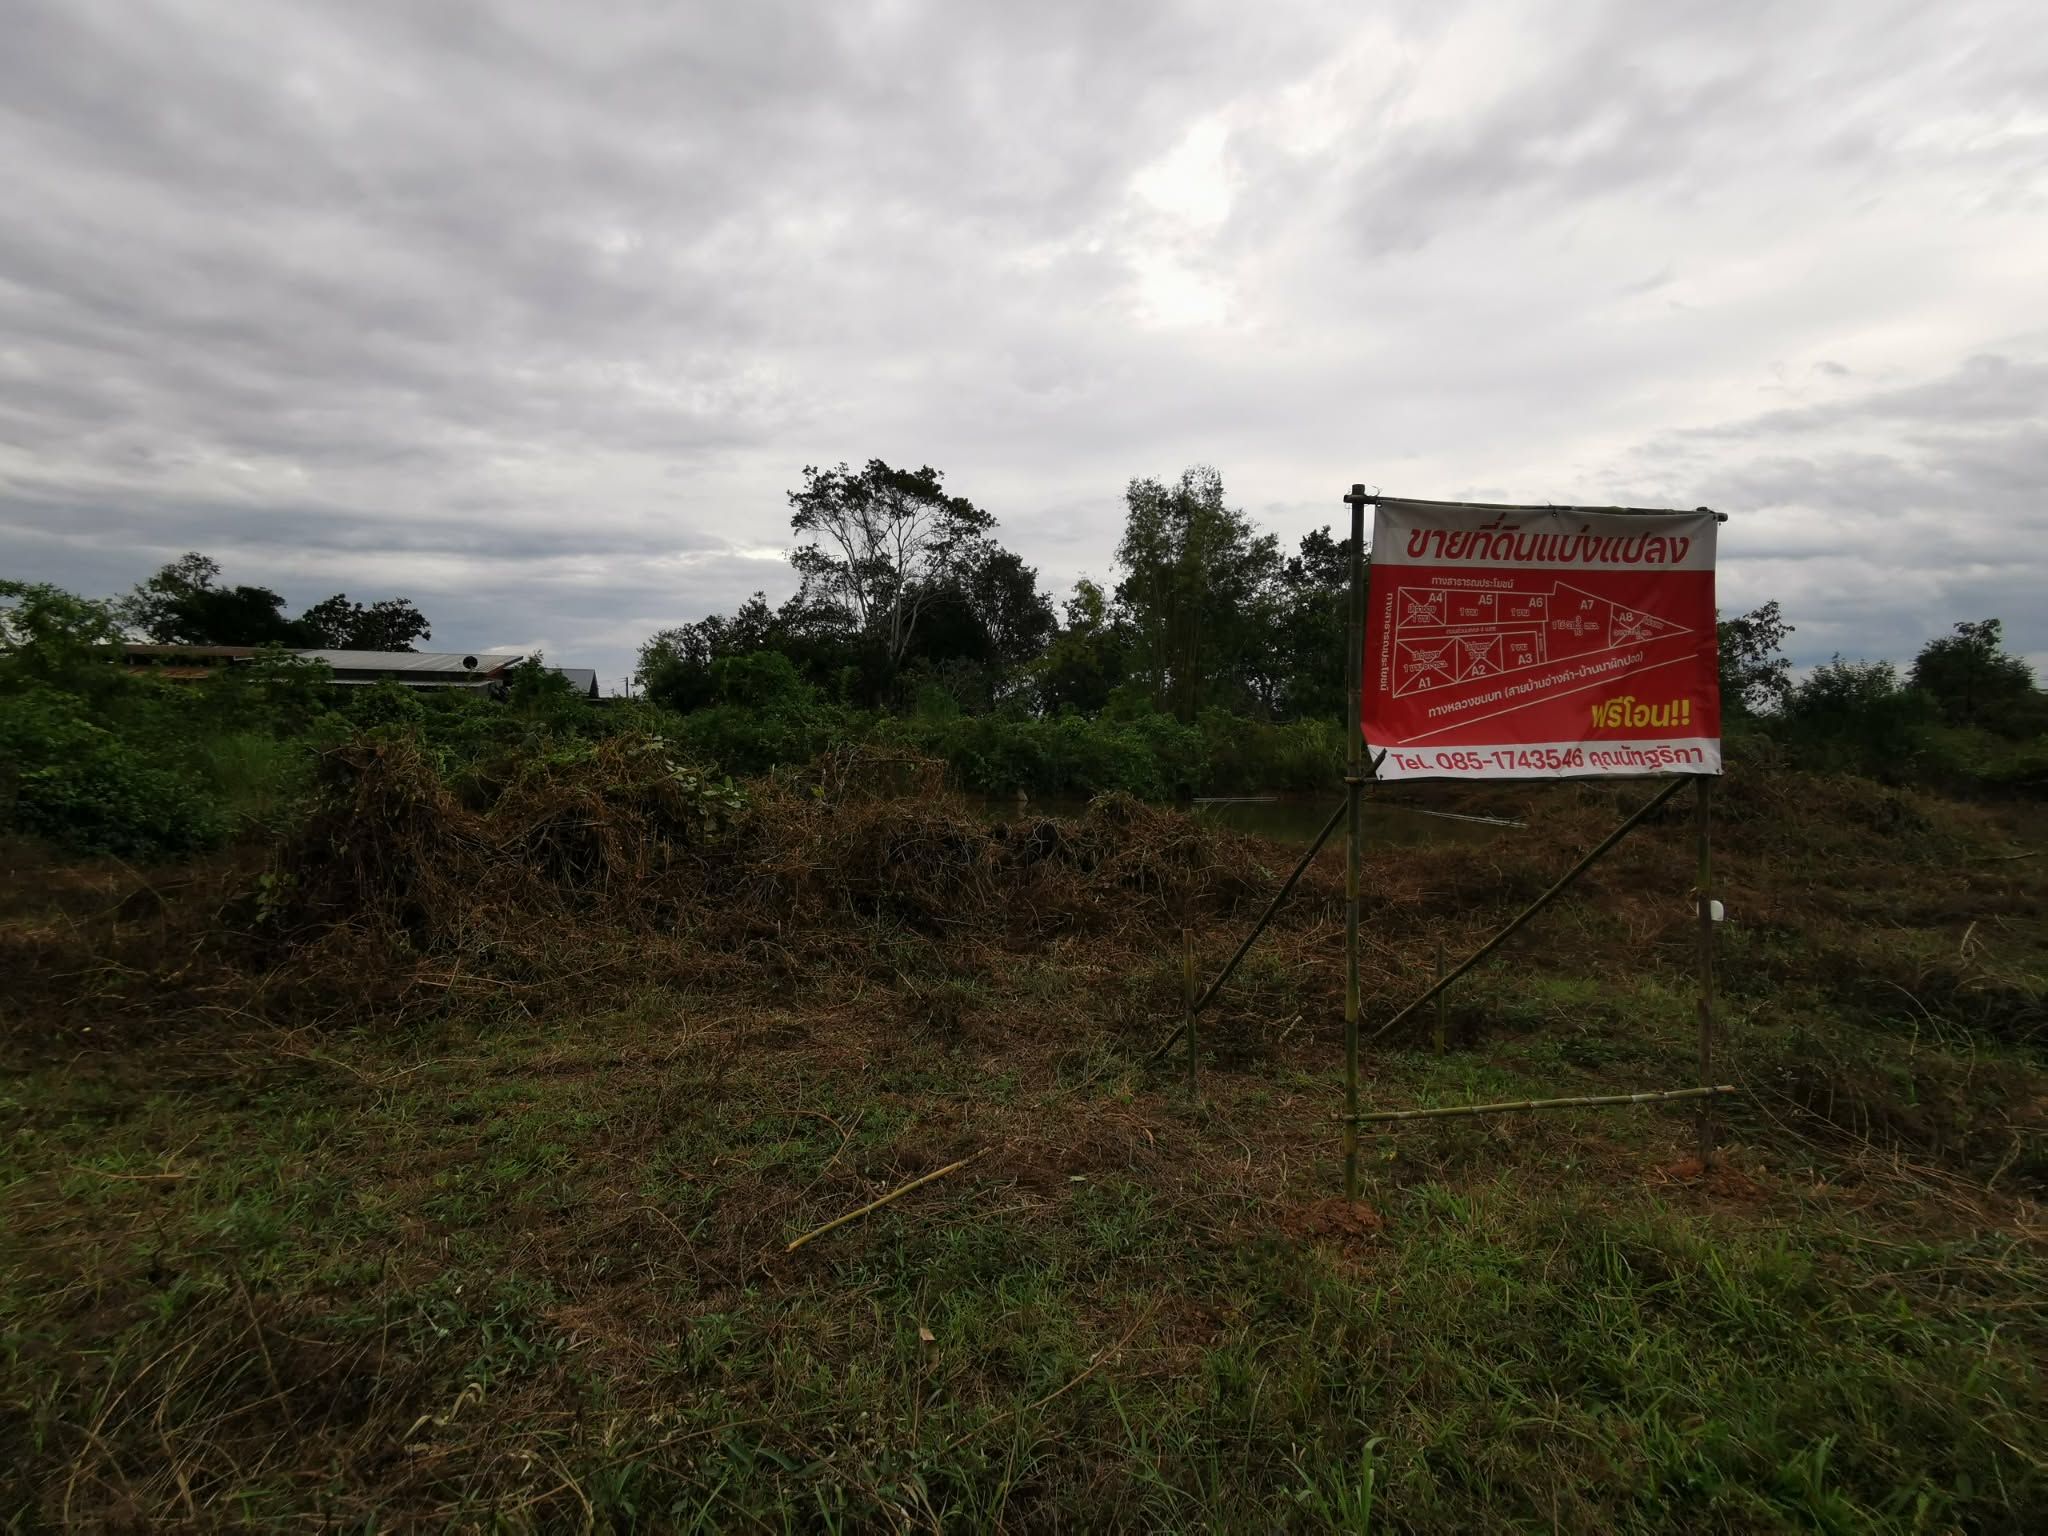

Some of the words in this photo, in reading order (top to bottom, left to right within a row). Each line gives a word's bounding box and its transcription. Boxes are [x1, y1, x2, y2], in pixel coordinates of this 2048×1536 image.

[1407, 512, 1690, 563] ขายที่ดินแบ่งแปลง
[1428, 592, 1443, 603] A4
[1478, 594, 1493, 605] A5
[1528, 597, 1544, 608] A6
[1580, 599, 1594, 610] A7
[1618, 612, 1634, 622] A8
[1518, 653, 1533, 665] A3
[1471, 664, 1486, 677] A2
[1418, 677, 1431, 689] A1
[1428, 689, 1502, 718] ทางหลวงชนบท
[1591, 696, 1690, 728] ฟรีโอน!!
[1436, 747, 1583, 770] 085-1743546
